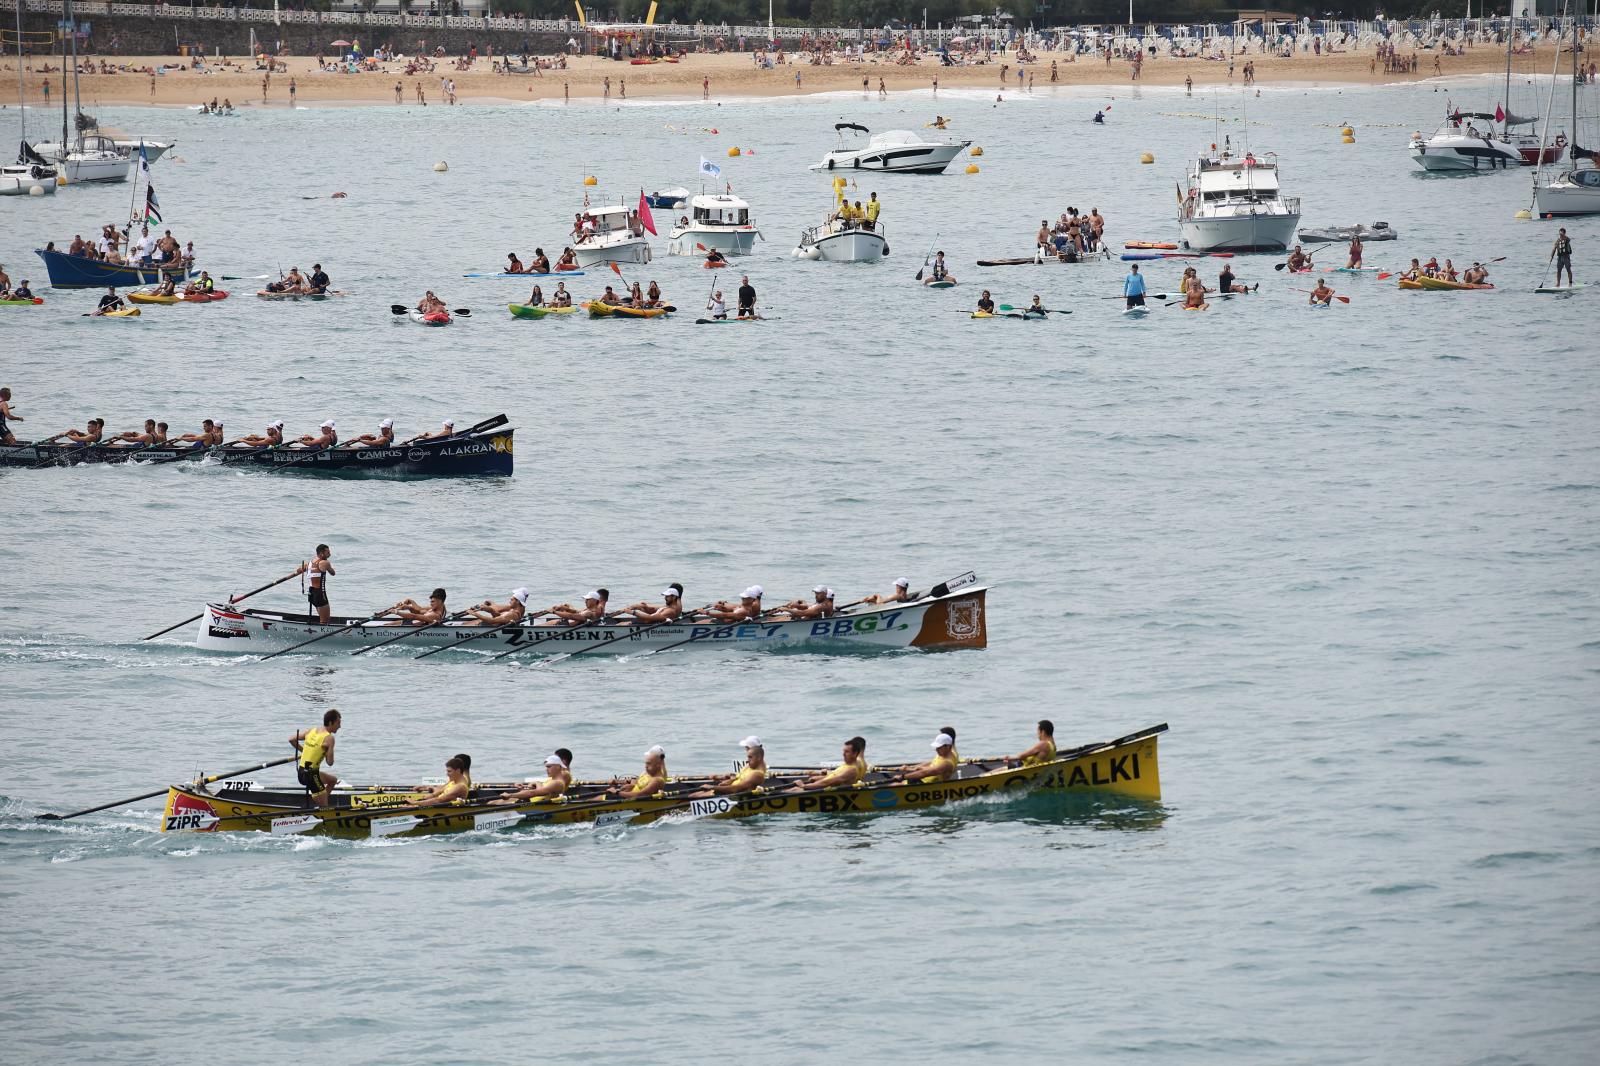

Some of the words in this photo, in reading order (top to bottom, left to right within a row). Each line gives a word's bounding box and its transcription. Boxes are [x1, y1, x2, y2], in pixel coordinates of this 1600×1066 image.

[356, 449, 402, 460] CAMPOS
[439, 442, 506, 456] ALAKRANA
[904, 784, 990, 802] ORBINOX
[691, 799, 730, 816] INDO
[798, 793, 861, 813] PBX
[475, 819, 508, 832] aldinet
